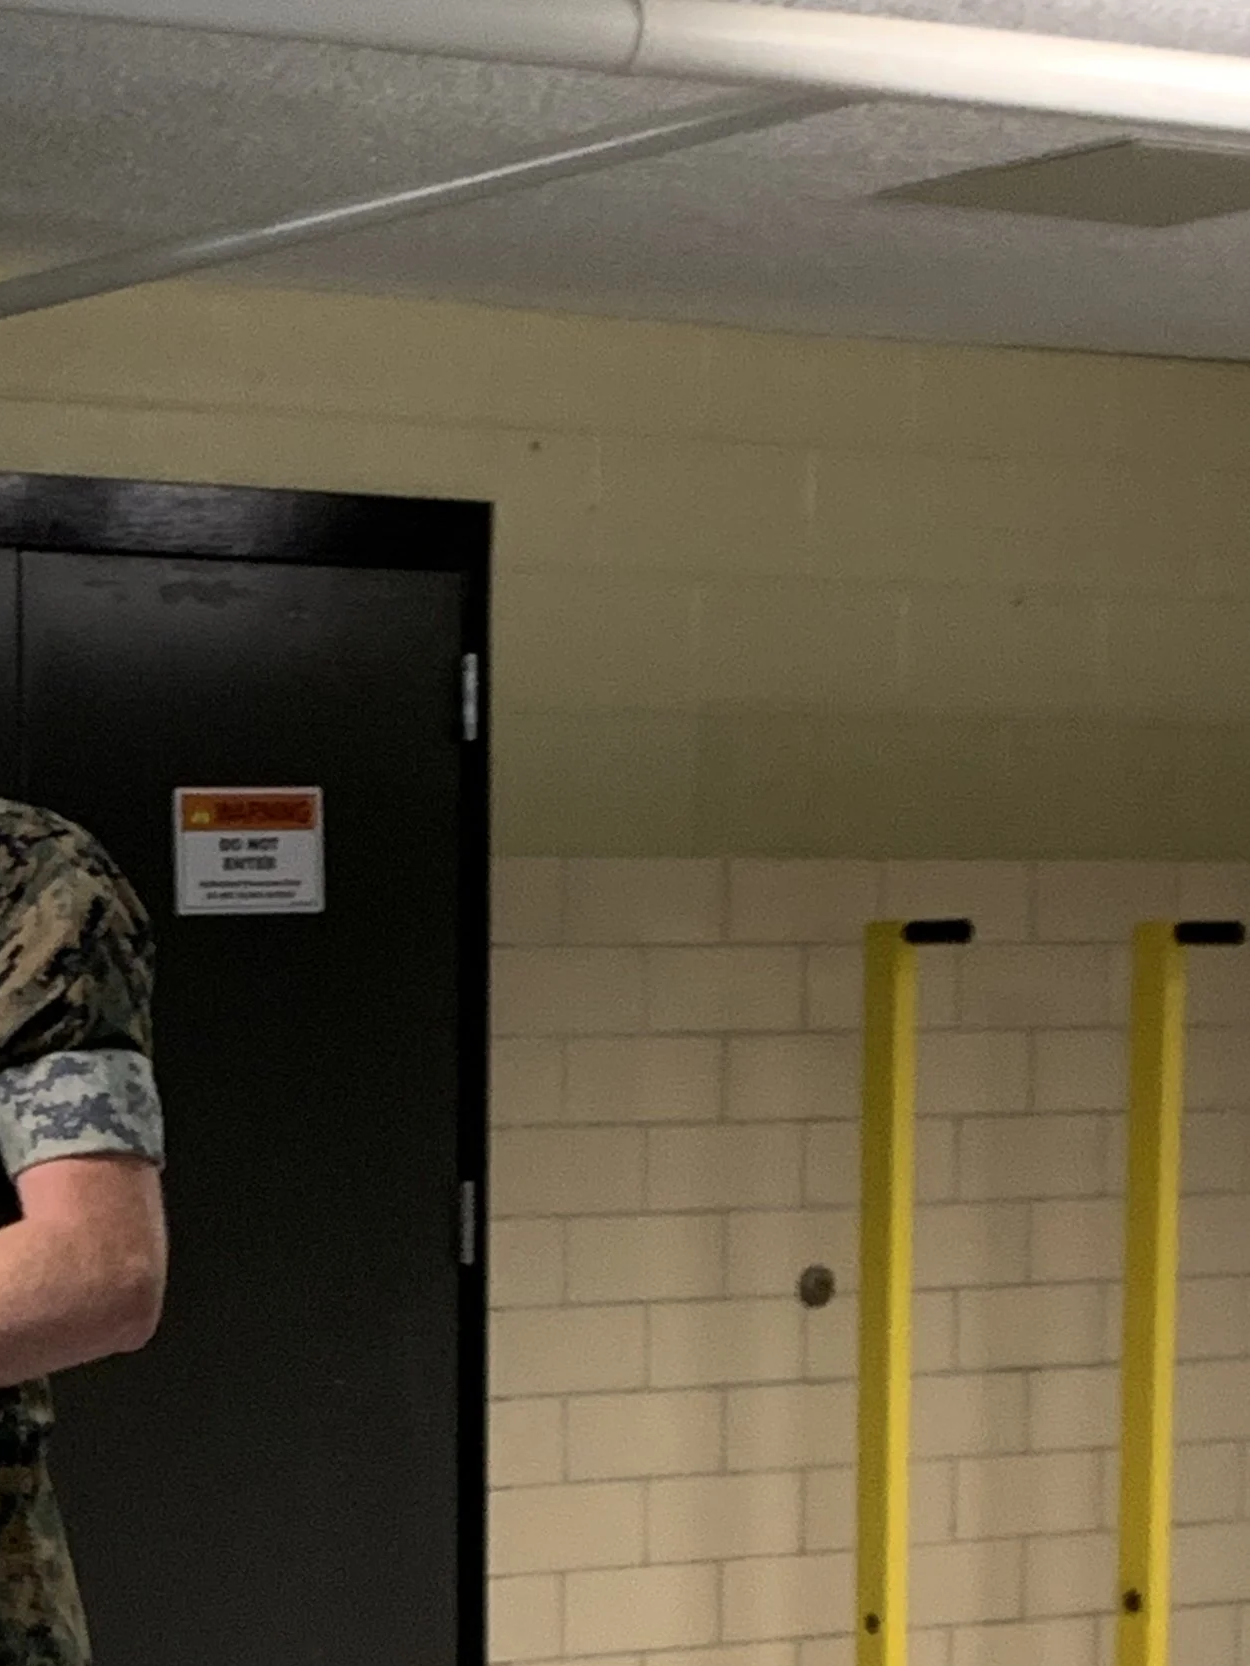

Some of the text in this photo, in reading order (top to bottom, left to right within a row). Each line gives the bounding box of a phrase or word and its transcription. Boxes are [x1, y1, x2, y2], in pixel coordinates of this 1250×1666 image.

[219, 836, 279, 851] DO NOT
[223, 857, 276, 871] ENTER
